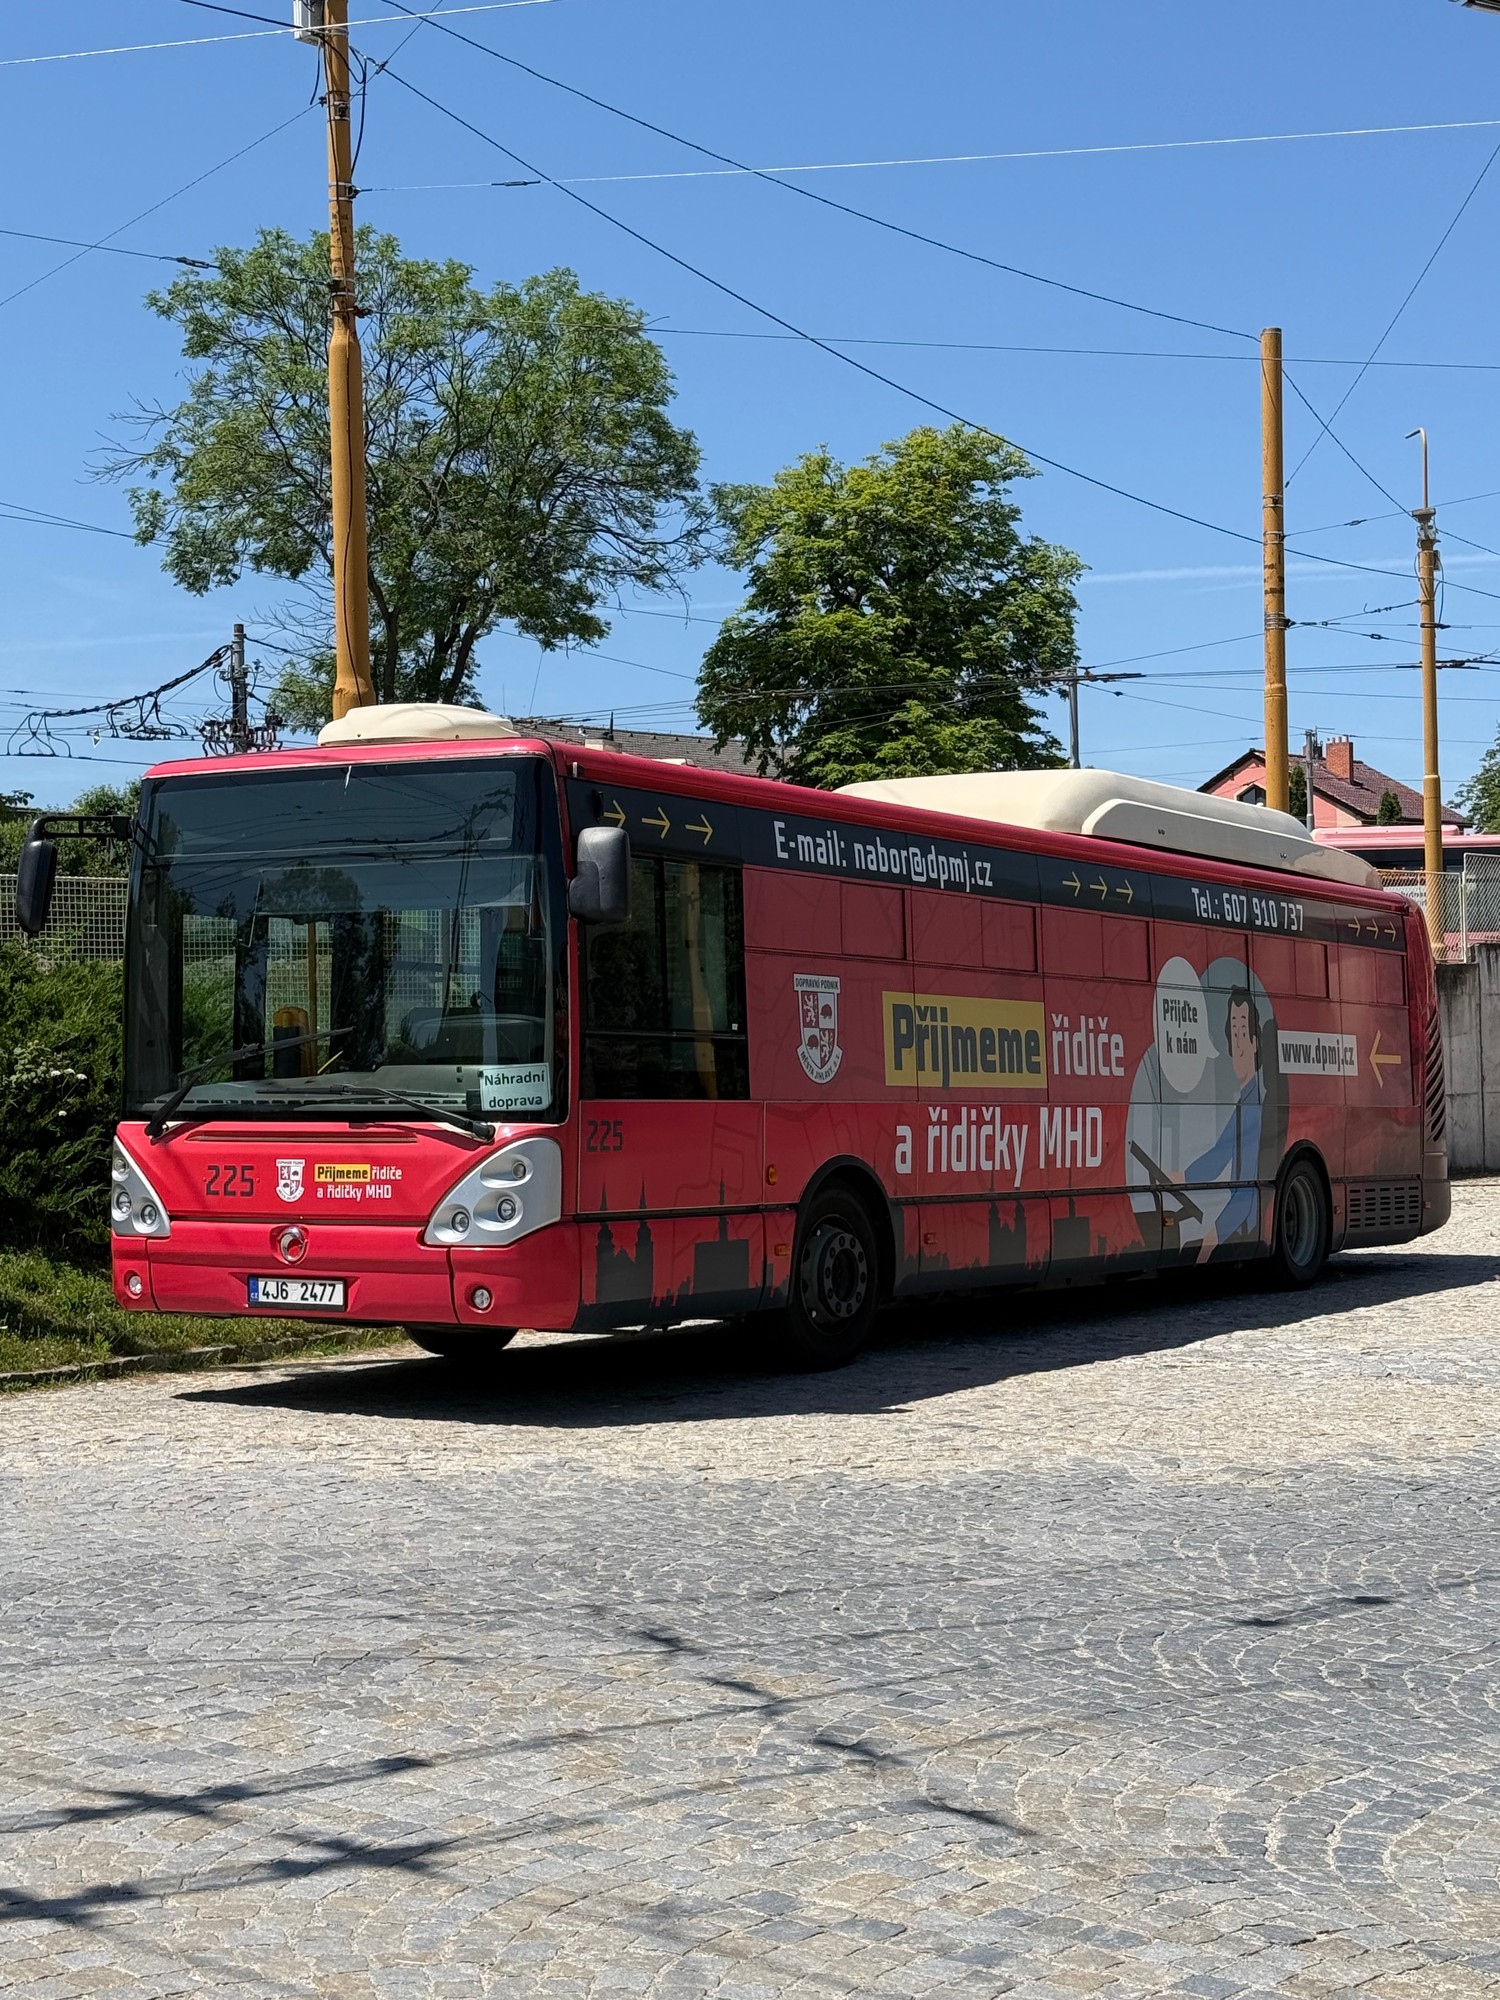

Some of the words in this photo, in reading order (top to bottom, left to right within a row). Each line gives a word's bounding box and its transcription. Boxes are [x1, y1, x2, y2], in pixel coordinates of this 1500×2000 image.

[773, 820, 847, 868] E-mail:
[853, 836, 993, 893] nabor@dpmj.cz
[1191, 887, 1220, 920] Tel.:
[1222, 892, 1247, 924] 607
[1252, 897, 1278, 928] 910
[1280, 901, 1304, 932] 737
[1162, 998, 1198, 1029] Přijďte
[891, 1003, 1041, 1089] Přijmeme
[1051, 1013, 1125, 1077] řidiče
[1166, 1030, 1173, 1054] k
[1176, 1031, 1198, 1054] nám
[1281, 1037, 1355, 1072] www.dpmj.cz
[484, 1070, 545, 1087] Náhradní
[489, 1094, 543, 1110] doprava
[586, 1119, 623, 1152] 225
[894, 1125, 912, 1174] a
[927, 1105, 1029, 1188] řidičky
[1039, 1107, 1103, 1169] MHD
[206, 1165, 254, 1197] 225
[317, 1166, 369, 1182] Přijmeme
[371, 1165, 403, 1180] řidiče
[316, 1187, 324, 1198] a
[326, 1184, 362, 1202] řidičky
[365, 1184, 392, 1199] MHD
[262, 1280, 289, 1300] 4J6
[300, 1282, 337, 1302] 2477
